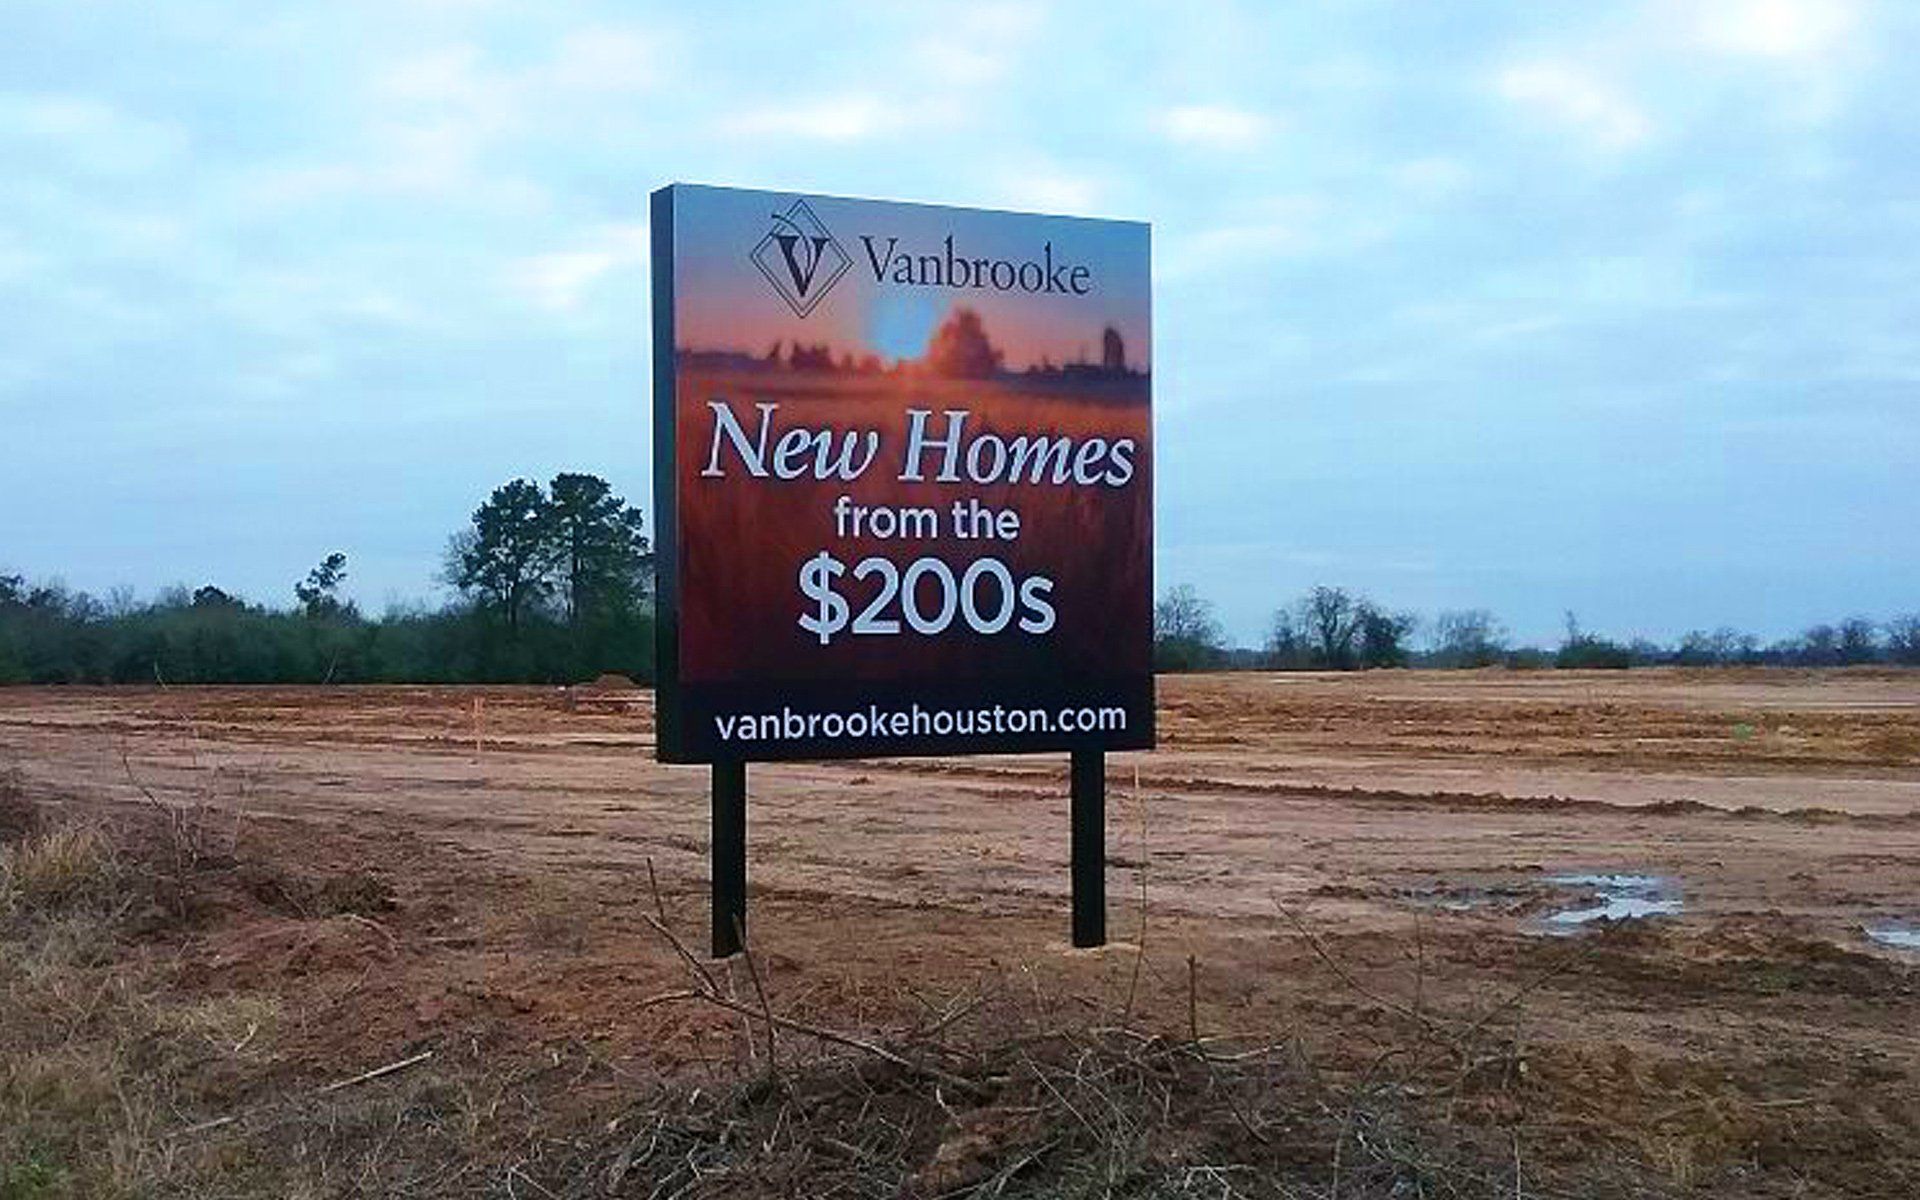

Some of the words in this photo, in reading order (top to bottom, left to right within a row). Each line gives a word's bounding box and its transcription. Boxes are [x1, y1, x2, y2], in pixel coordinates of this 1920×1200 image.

[859, 232, 1091, 296] Vanbrooke
[701, 401, 880, 481] New
[898, 408, 1137, 488] Homes
[834, 496, 938, 539] from
[952, 499, 1020, 540] the
[799, 550, 1057, 645] $200s
[715, 704, 1127, 741] vanbrookehouston.com
